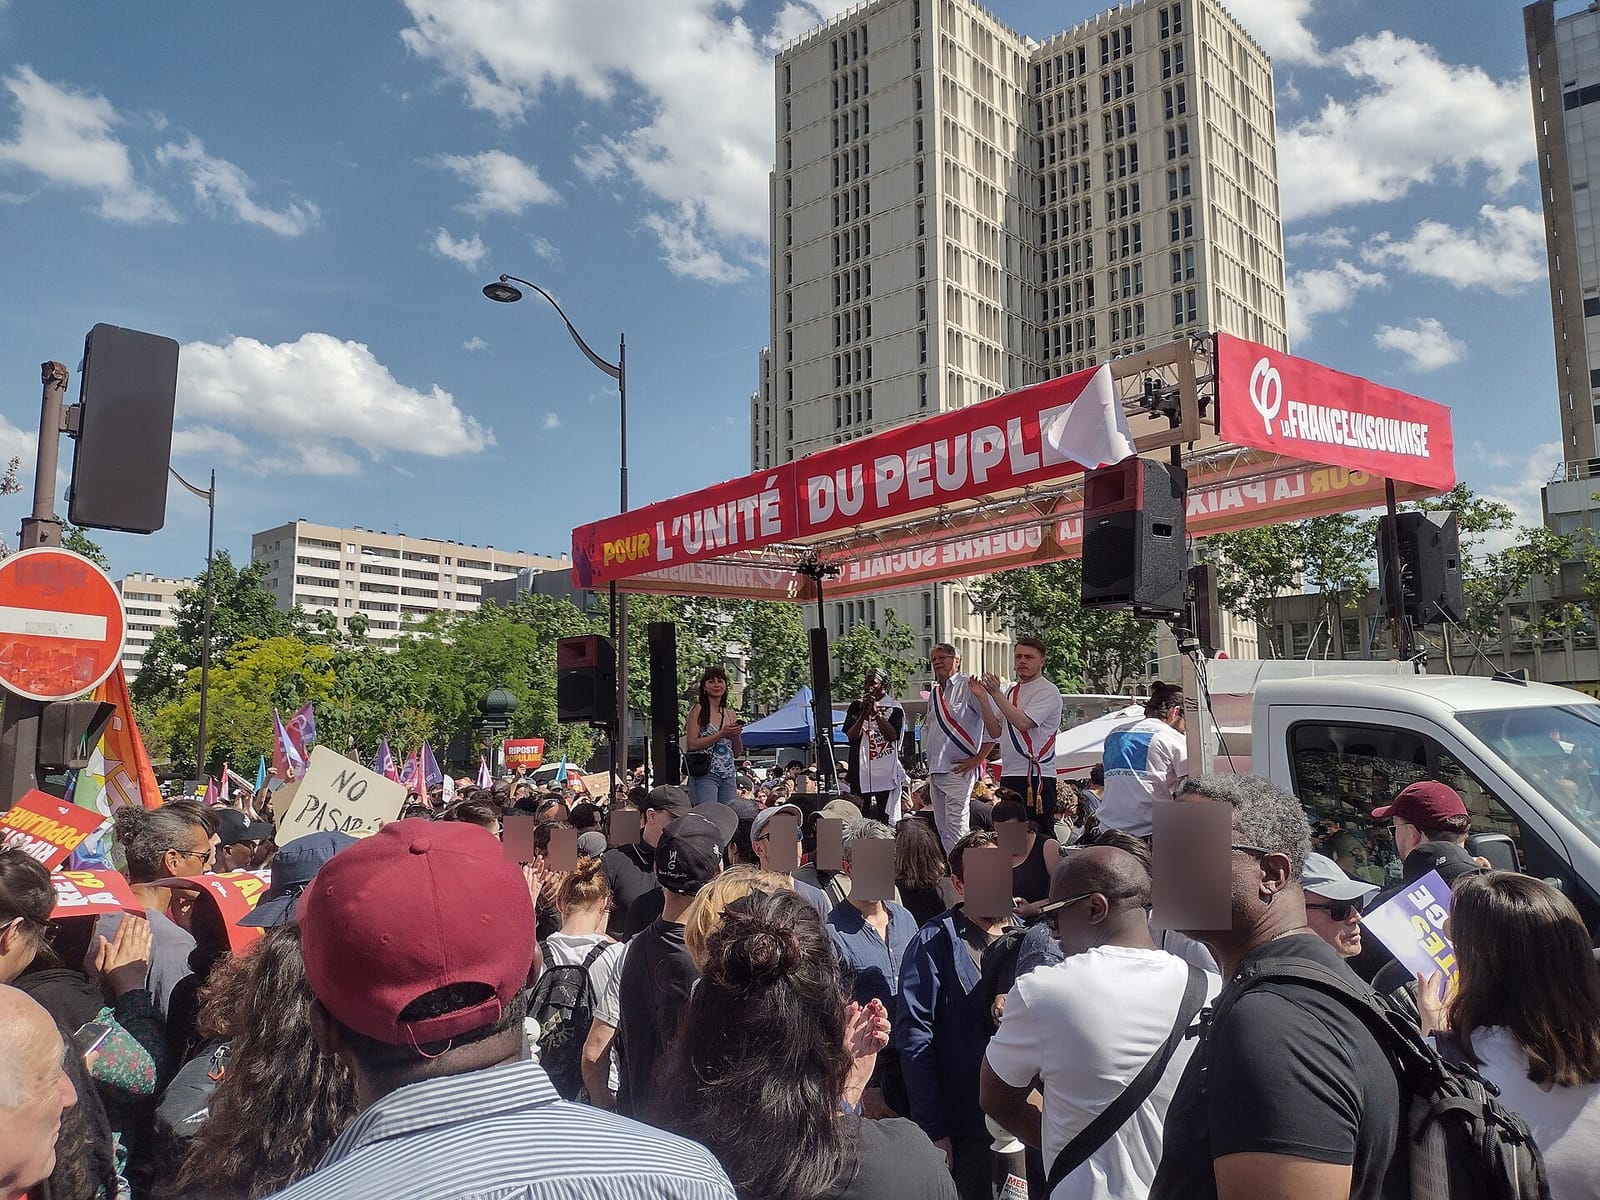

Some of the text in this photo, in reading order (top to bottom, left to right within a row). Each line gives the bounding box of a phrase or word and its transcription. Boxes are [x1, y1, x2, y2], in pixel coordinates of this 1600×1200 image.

[1280, 419, 1290, 438] LA
[603, 532, 650, 567] POUR
[656, 474, 782, 561] L'UNITÉ
[808, 464, 865, 525] DU
[505, 753, 543, 762] POPULAIRE
[508, 745, 539, 755] RIPOSTE
[330, 769, 368, 802] NO
[1, 806, 88, 851] POPULAIRE
